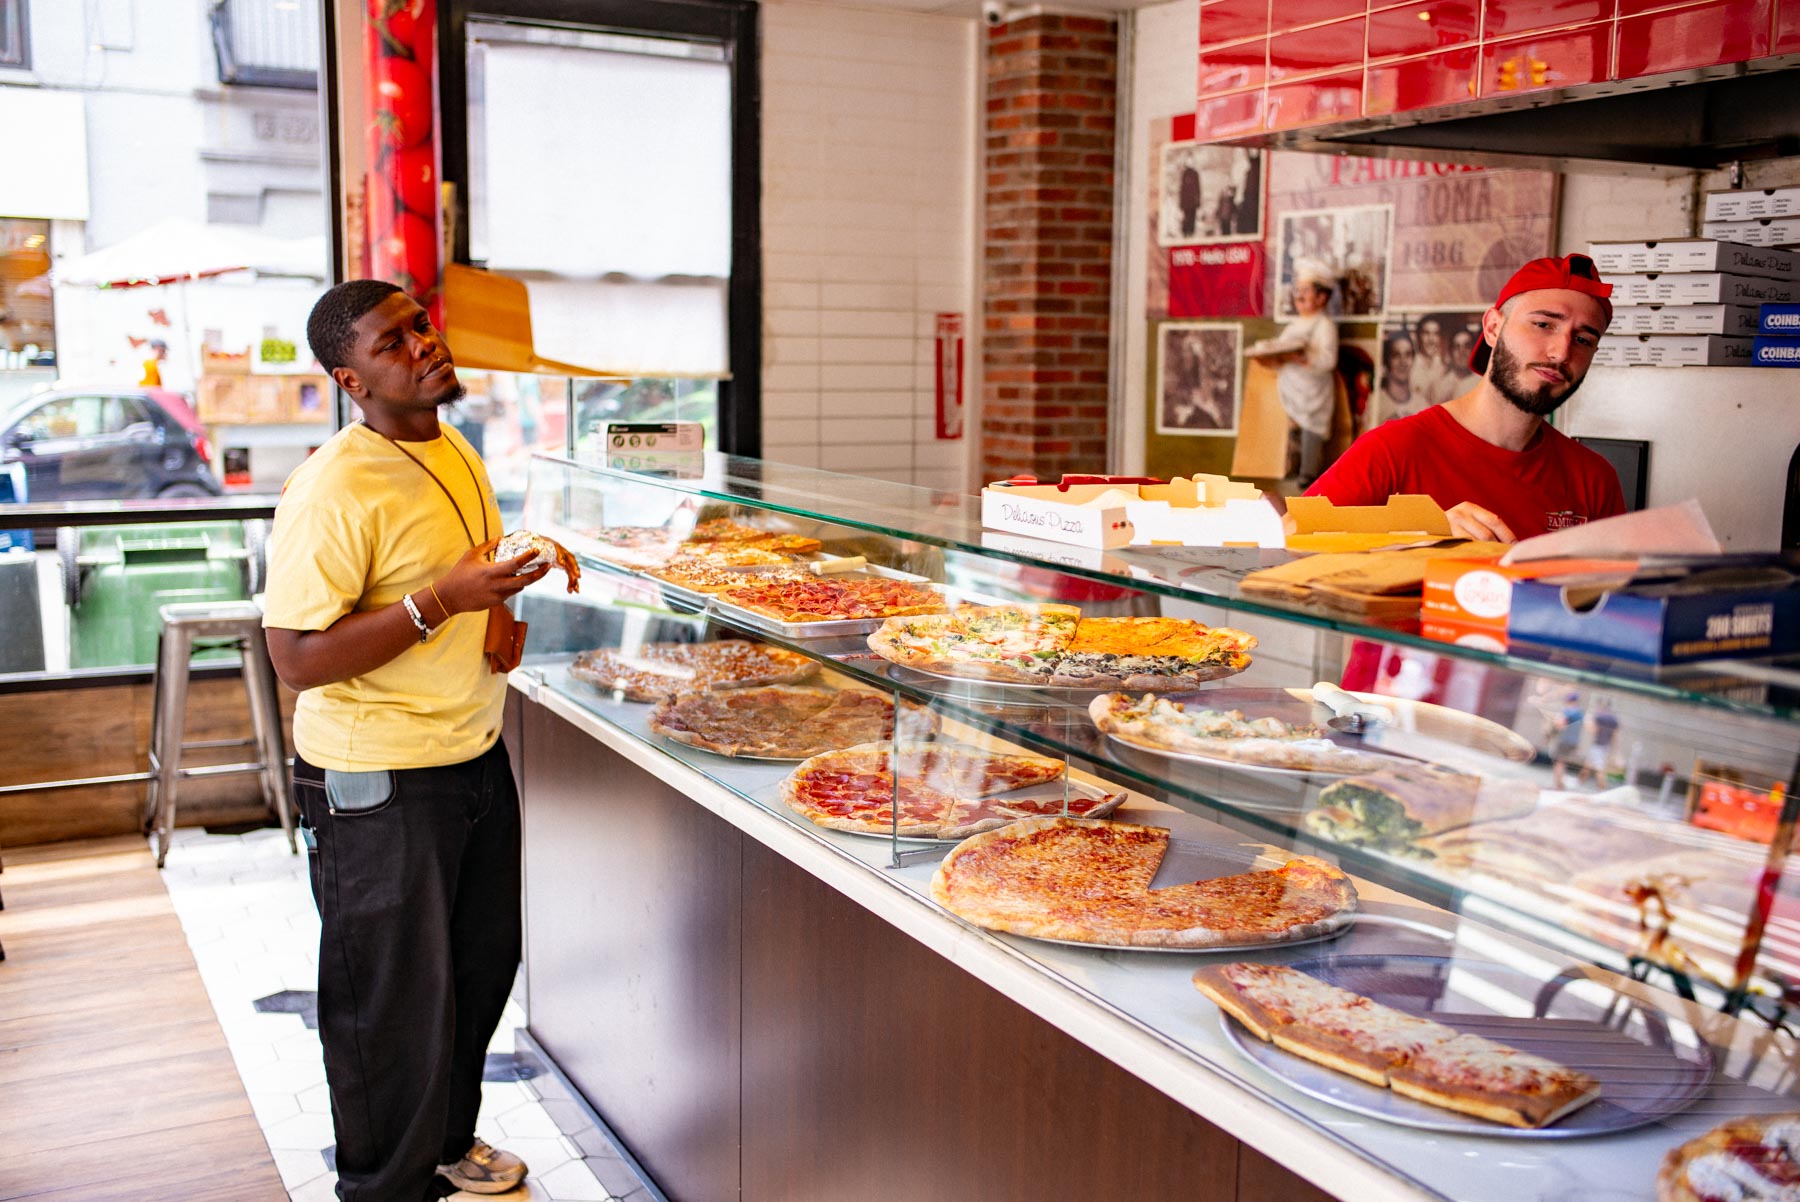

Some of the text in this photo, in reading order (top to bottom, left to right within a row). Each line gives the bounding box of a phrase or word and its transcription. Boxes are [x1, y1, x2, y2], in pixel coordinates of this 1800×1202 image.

[1415, 177, 1492, 225] ROMA
[1766, 313, 1800, 327] COINB
[1001, 503, 1084, 534] Delicious Pizza
